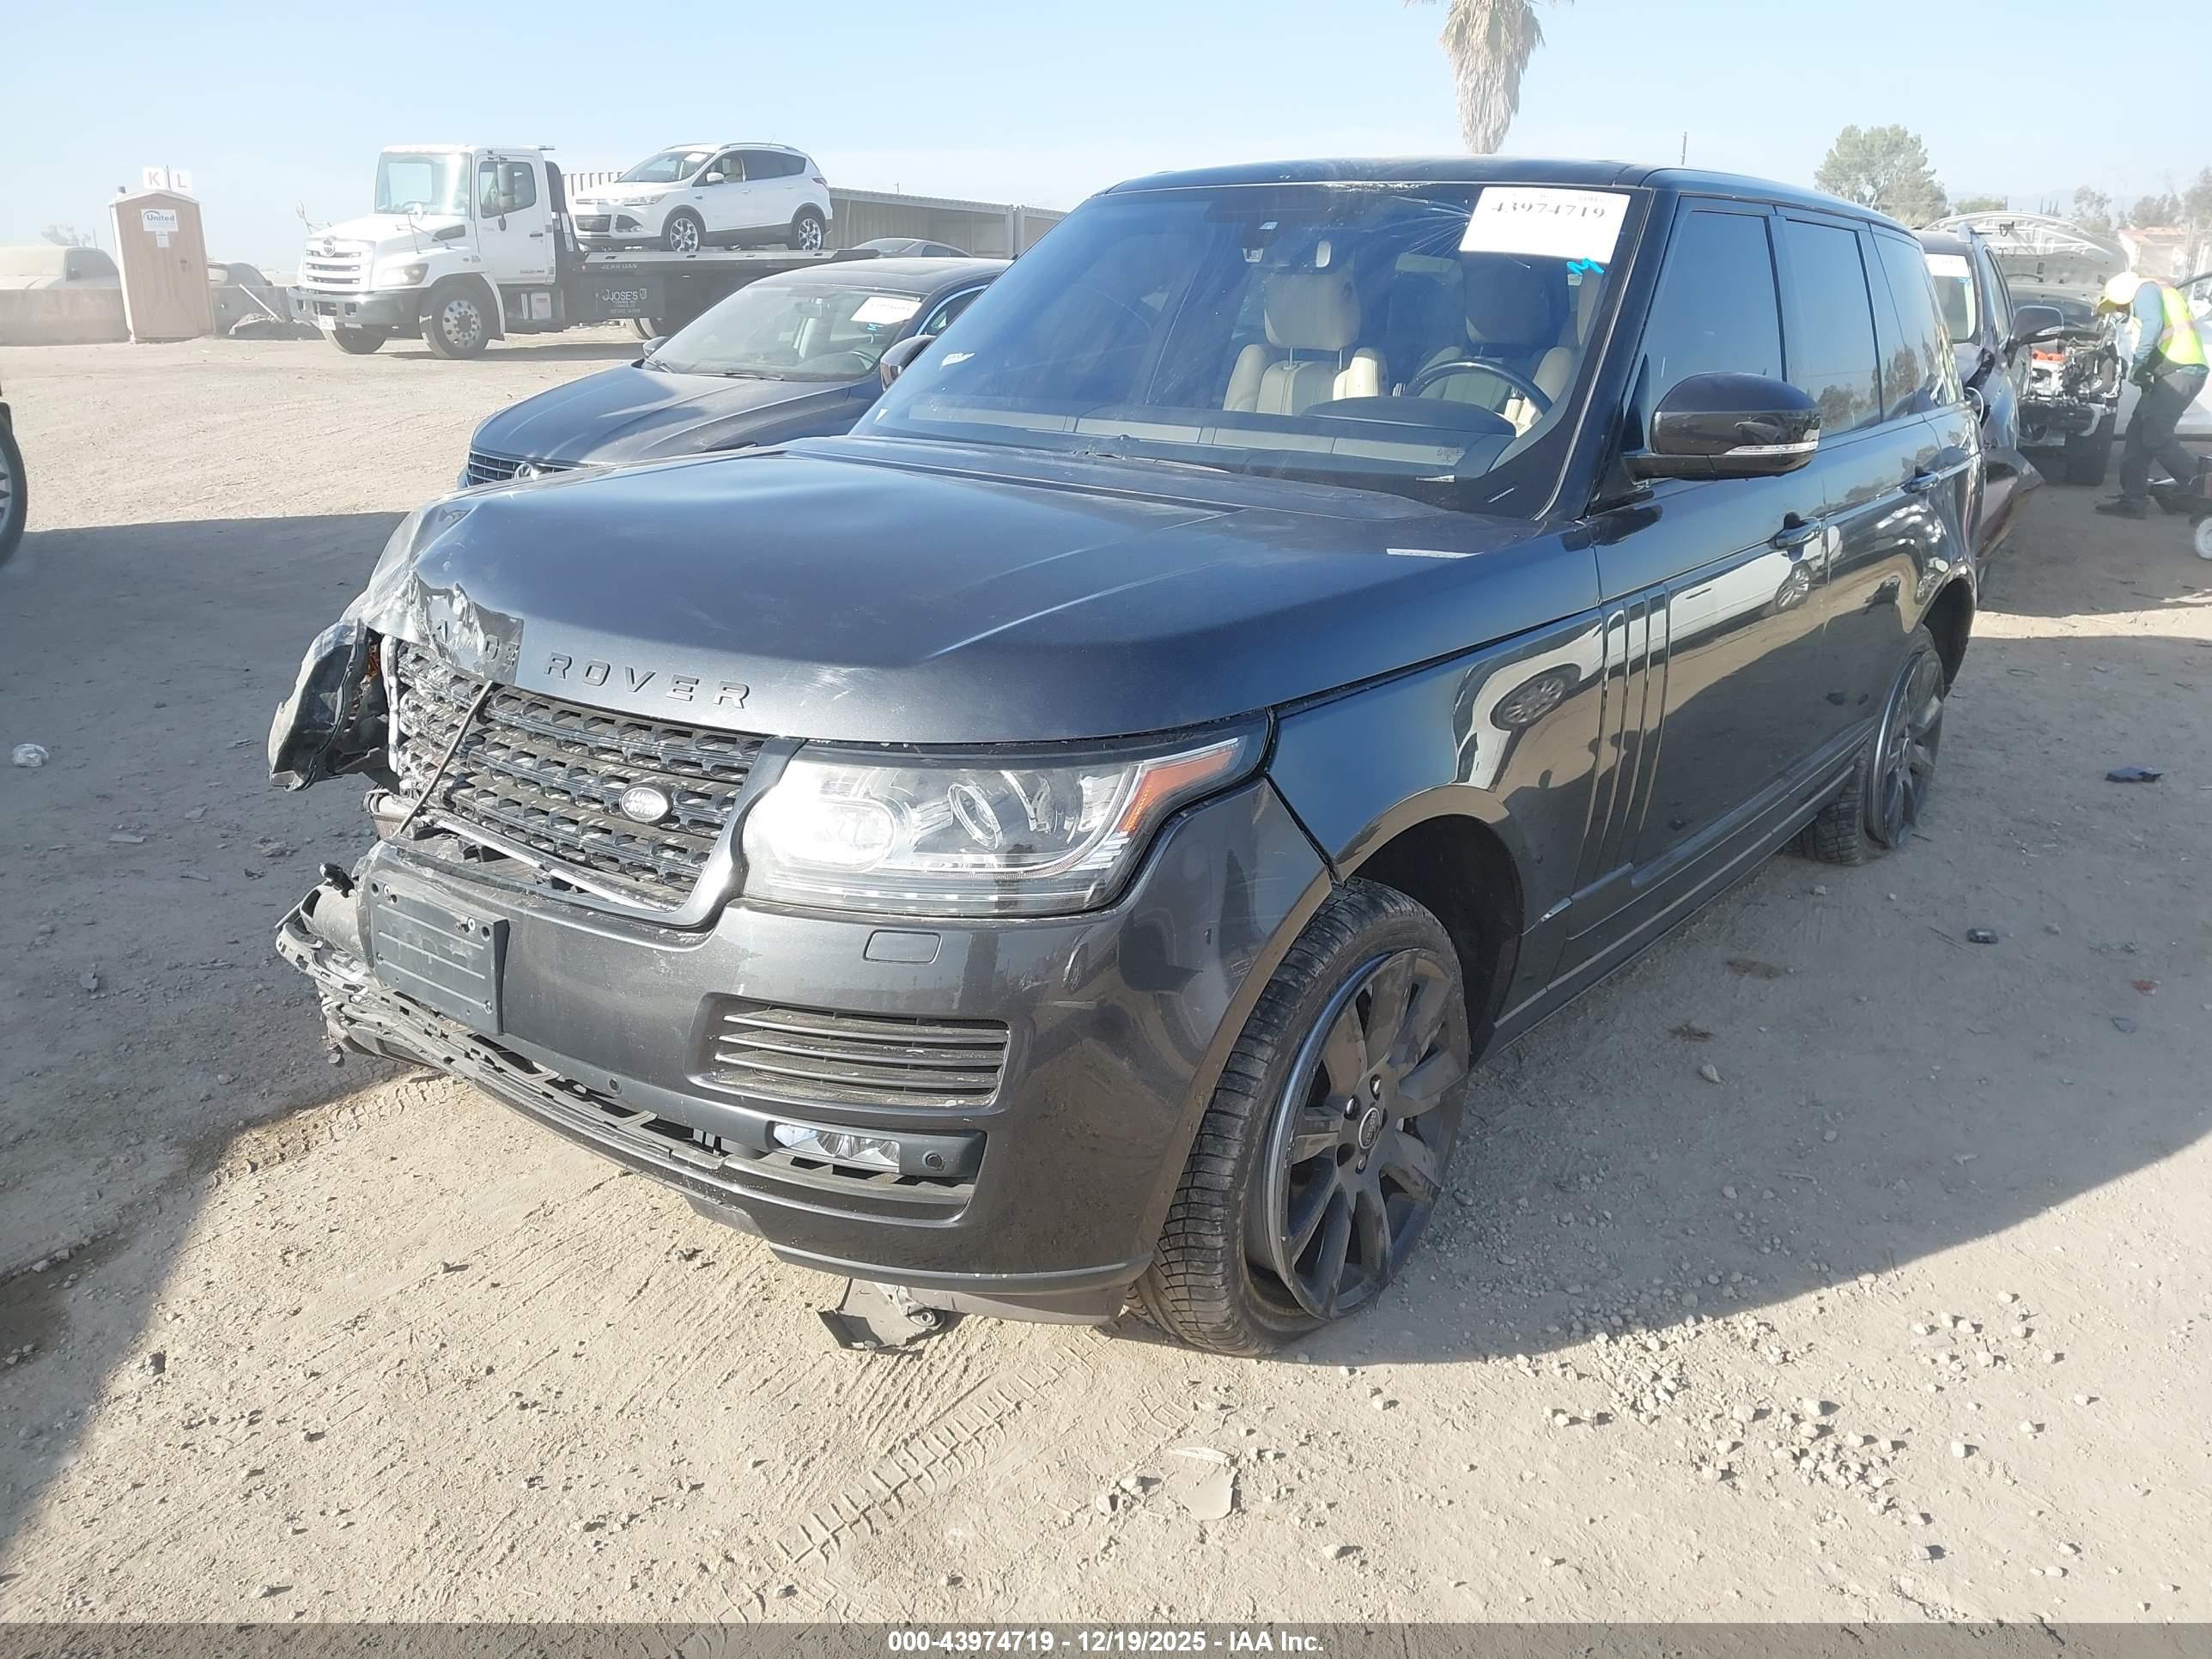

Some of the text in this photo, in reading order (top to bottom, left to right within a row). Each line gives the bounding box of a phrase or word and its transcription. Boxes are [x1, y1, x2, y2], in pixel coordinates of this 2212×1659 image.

[148, 171, 161, 186] K
[176, 173, 187, 188] L
[610, 291, 639, 301] JOSE'S
[544, 652, 750, 708] ROVER
